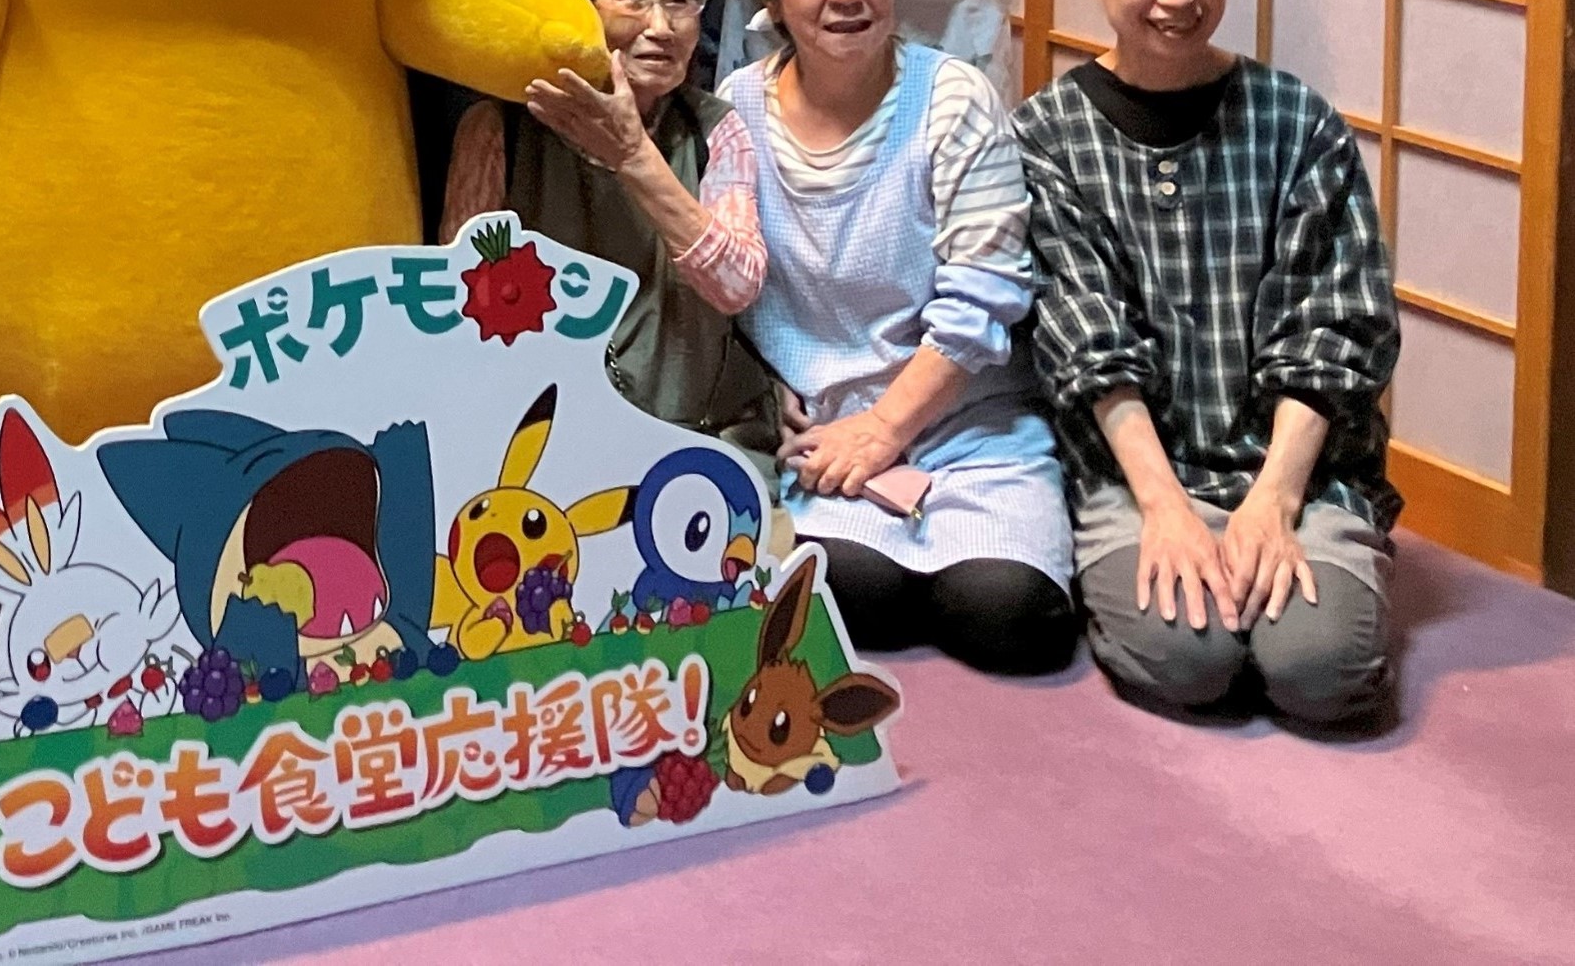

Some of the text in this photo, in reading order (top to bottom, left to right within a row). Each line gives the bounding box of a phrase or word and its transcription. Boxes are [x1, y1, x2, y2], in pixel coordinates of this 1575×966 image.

[220, 257, 629, 391] ポケモン
[179, 916, 213, 929] FREAK
